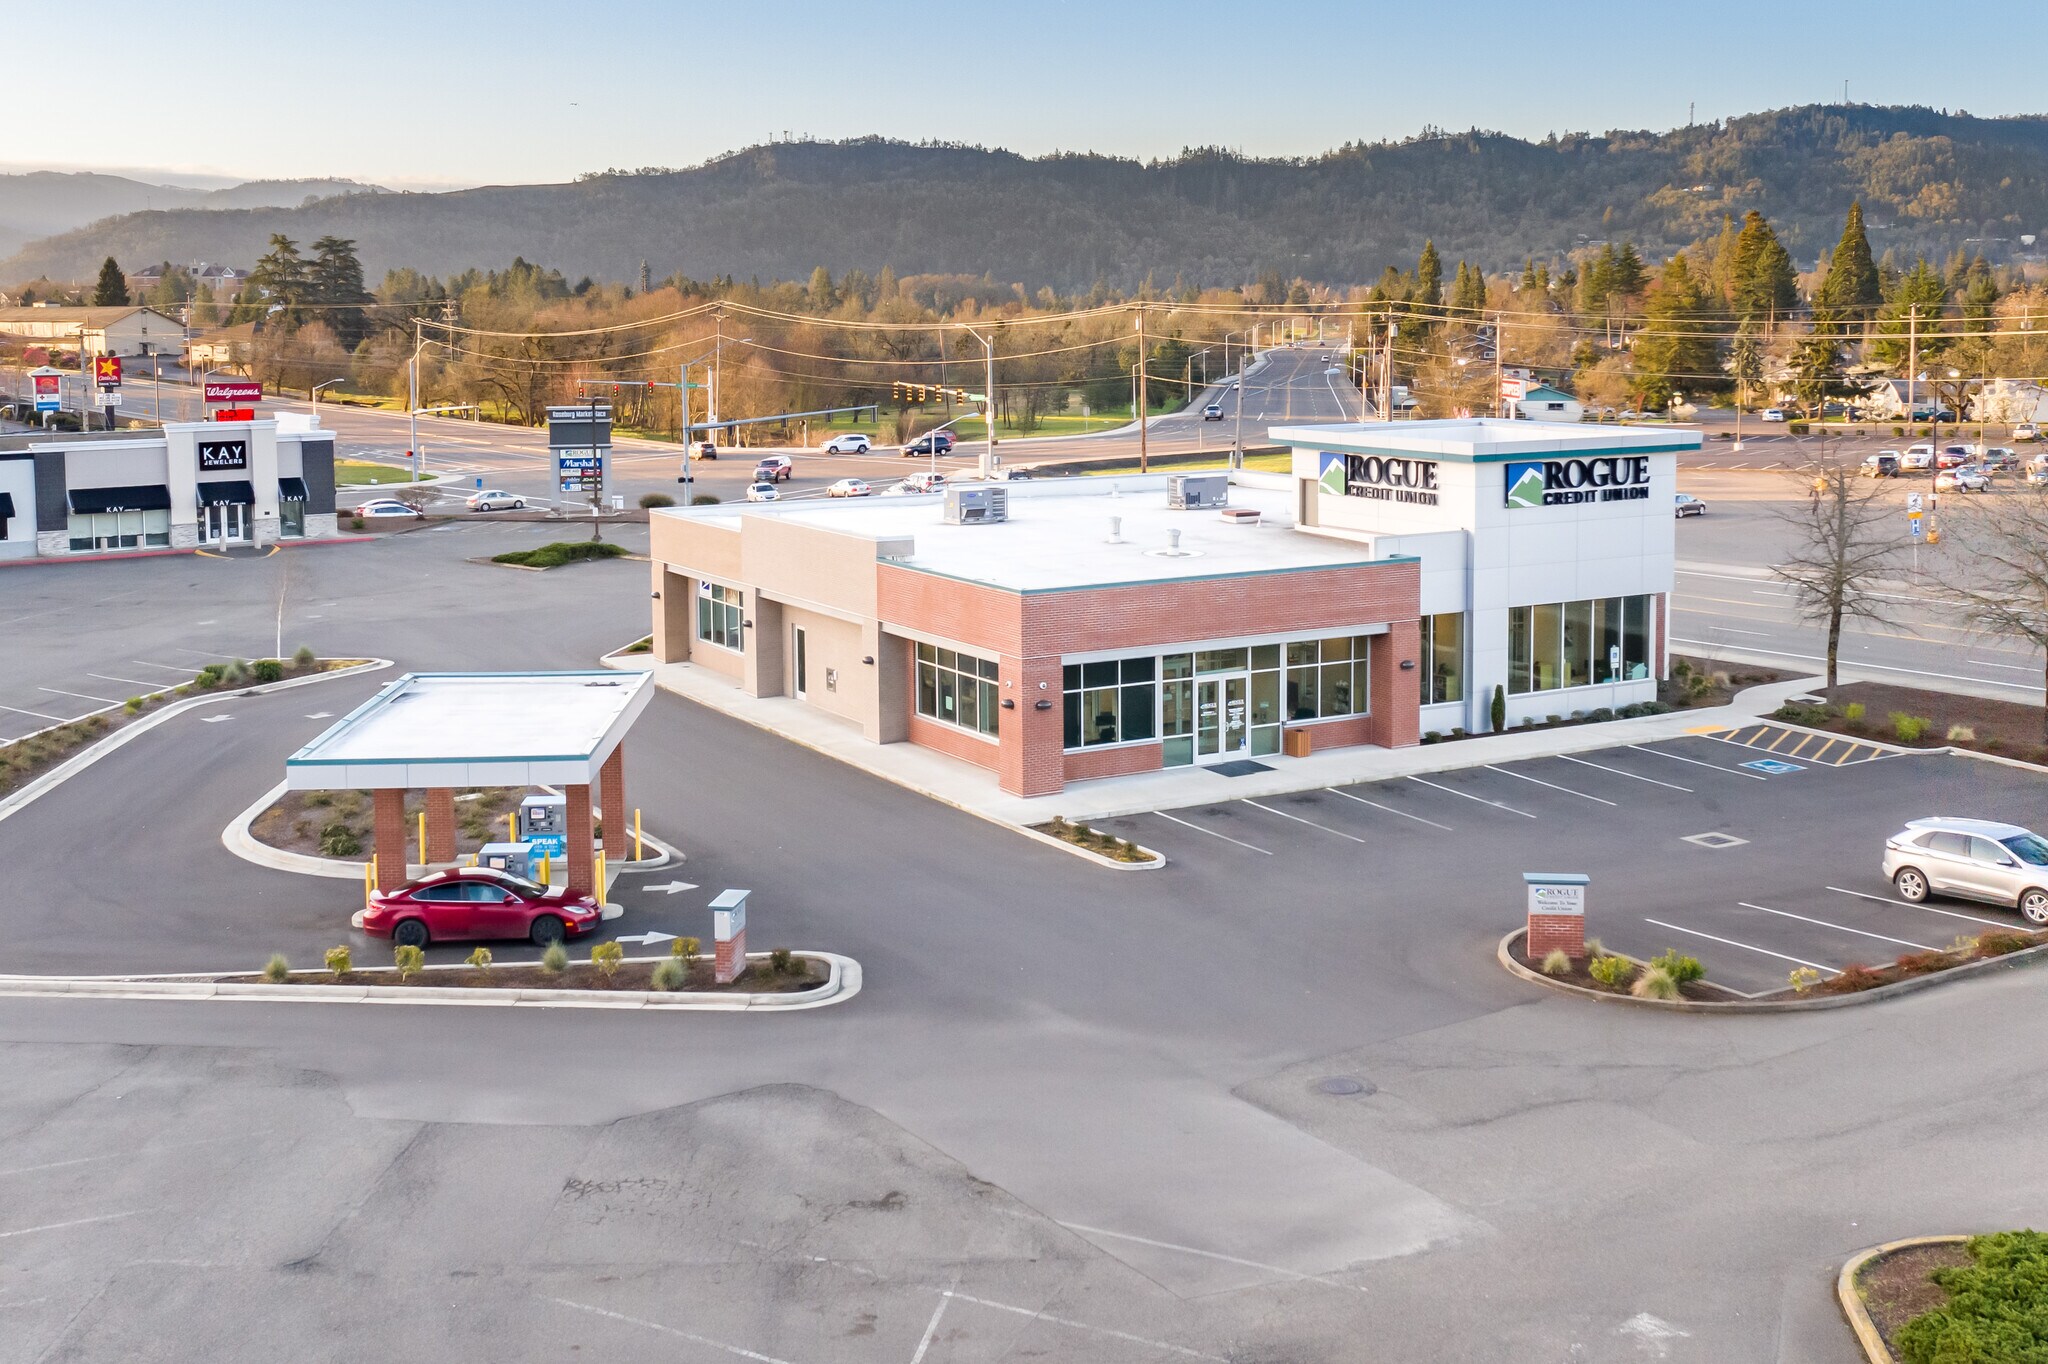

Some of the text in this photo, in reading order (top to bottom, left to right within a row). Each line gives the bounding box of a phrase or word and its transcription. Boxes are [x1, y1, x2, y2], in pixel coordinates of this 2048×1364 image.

[206, 386, 260, 399] Walgreens
[203, 446, 242, 460] KAY
[1348, 454, 1439, 490] ROGUE
[1544, 456, 1650, 490] ROGUE
[1348, 484, 1439, 506] CREDIT UNION
[1544, 487, 1649, 505] CREDIT UNION
